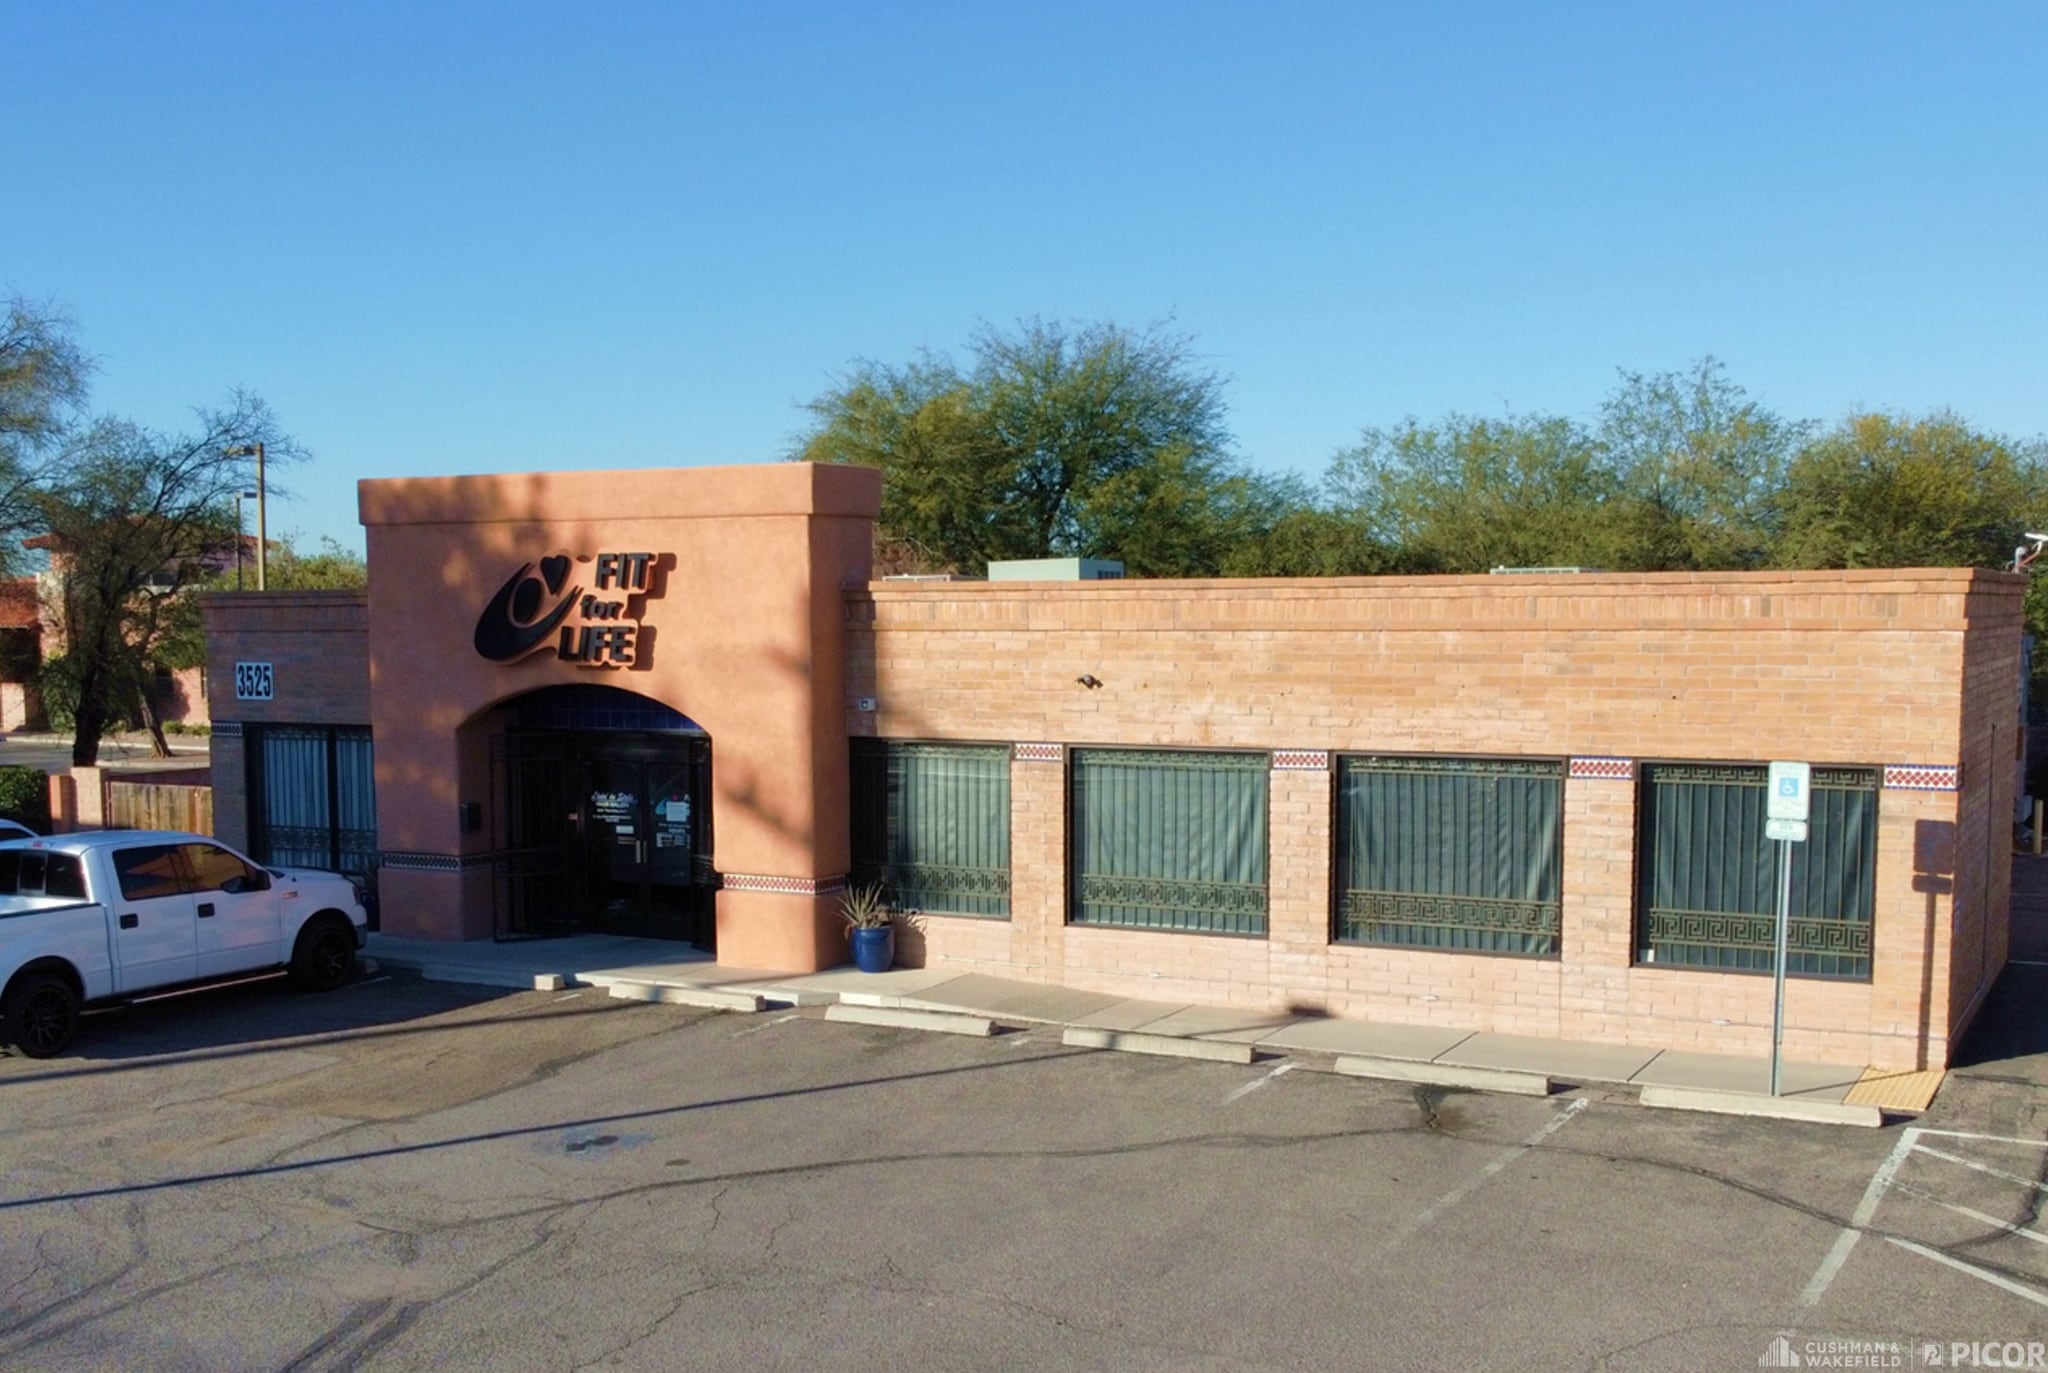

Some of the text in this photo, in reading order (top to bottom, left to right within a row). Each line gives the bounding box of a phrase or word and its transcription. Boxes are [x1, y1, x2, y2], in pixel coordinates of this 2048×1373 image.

[596, 553, 655, 590] FIT
[580, 595, 623, 620] for
[558, 626, 635, 661] LIFE
[238, 664, 271, 697] 3525
